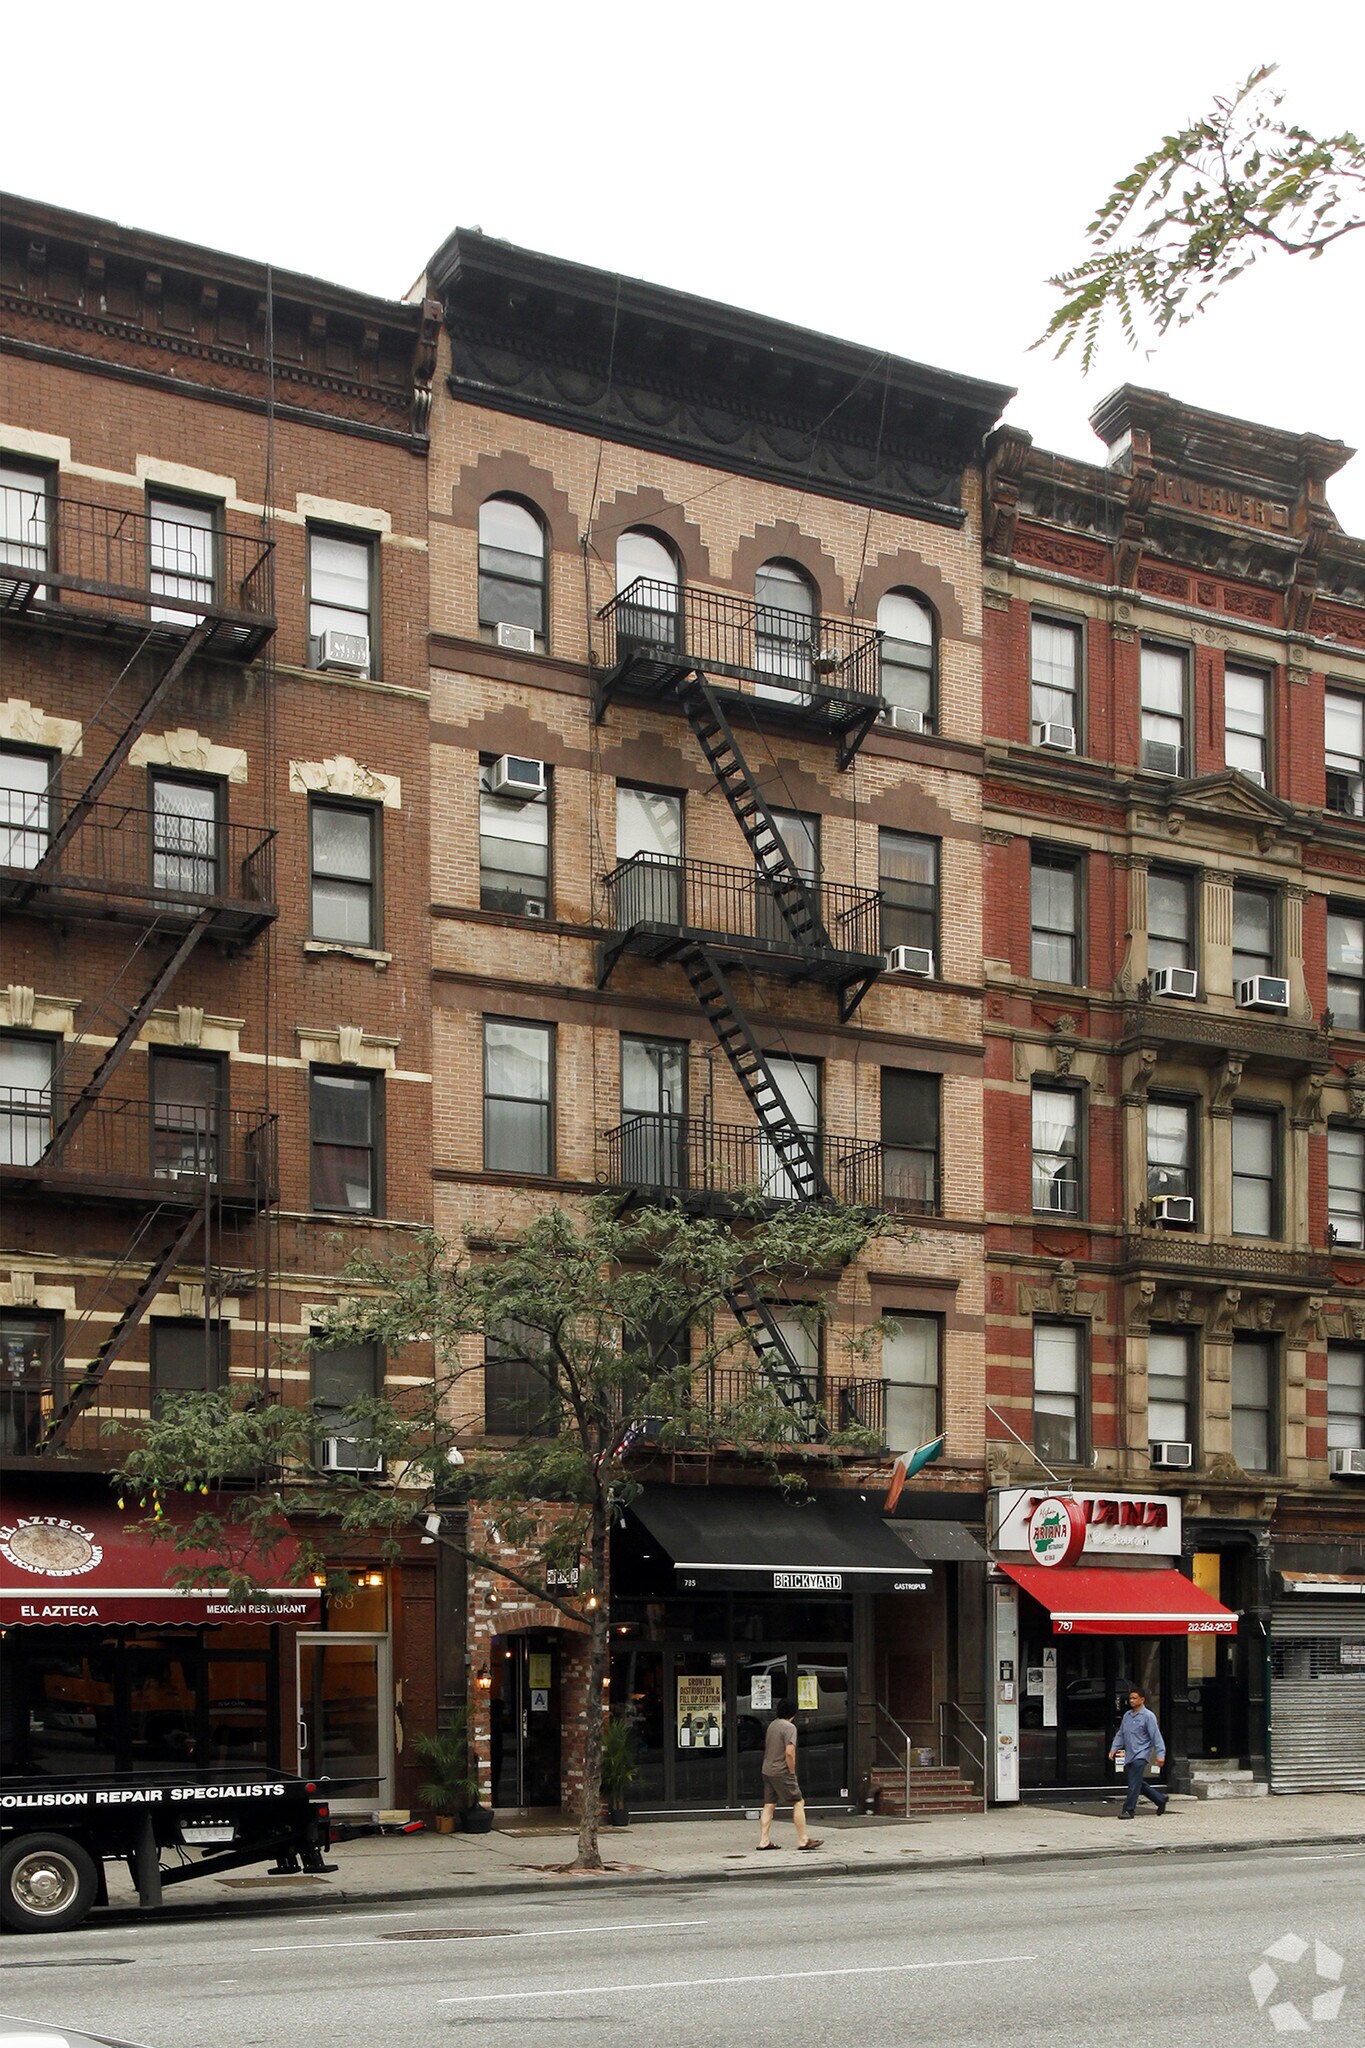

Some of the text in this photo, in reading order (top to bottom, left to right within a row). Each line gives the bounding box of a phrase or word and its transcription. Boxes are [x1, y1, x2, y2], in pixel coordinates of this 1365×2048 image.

[1023, 1497, 1168, 1527] IANA
[0, 1516, 95, 1542] EL AZTECA
[1033, 1525, 1067, 1540] ARIANA
[0, 1543, 103, 1577] MEXICAN RESTAURANT
[773, 1573, 842, 1590] BRICKYARD
[324, 1592, 354, 1609] 783
[20, 1605, 99, 1617] EL AZTECA
[206, 1604, 247, 1614] MEXICAN
[1057, 1621, 1073, 1631] 787
[1046, 1650, 1054, 1662] A
[688, 1678, 711, 1686] GROWLER
[680, 1687, 720, 1695] DISTRIBUTION &
[534, 1693, 545, 1706] A
[680, 1695, 690, 1703] FILL
[699, 1695, 720, 1703] STATION
[0, 1784, 285, 1808] OLLISION REPAIR SPECIALISTS
